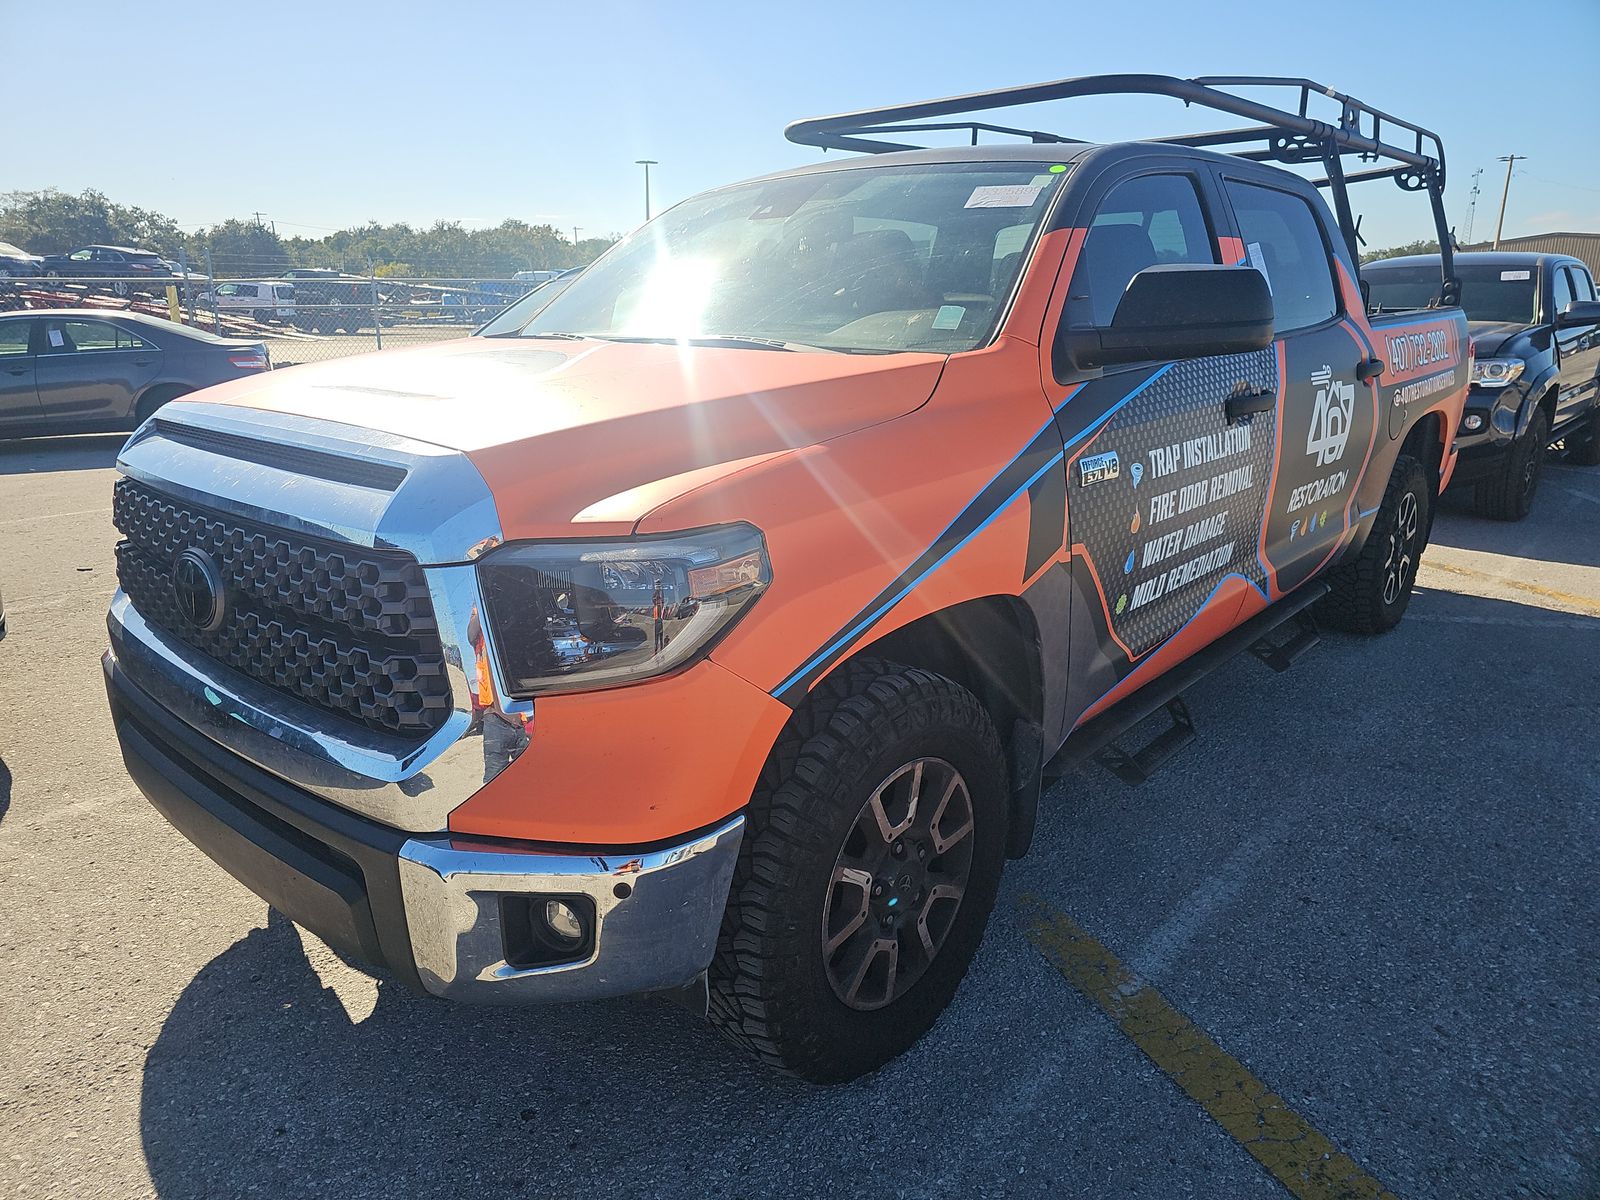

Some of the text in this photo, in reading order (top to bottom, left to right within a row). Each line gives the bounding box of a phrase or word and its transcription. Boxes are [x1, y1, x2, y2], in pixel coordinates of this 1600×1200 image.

[1104, 457, 1118, 476] V8
[1148, 425, 1251, 480] TRAP INSTALLATION
[1148, 464, 1254, 526] FIRE ODOR REMOVAL
[1286, 468, 1350, 514] RESTORATION
[1141, 510, 1229, 569] WATER DAMAGE
[1129, 540, 1236, 612] MOLD REMEDIATION
